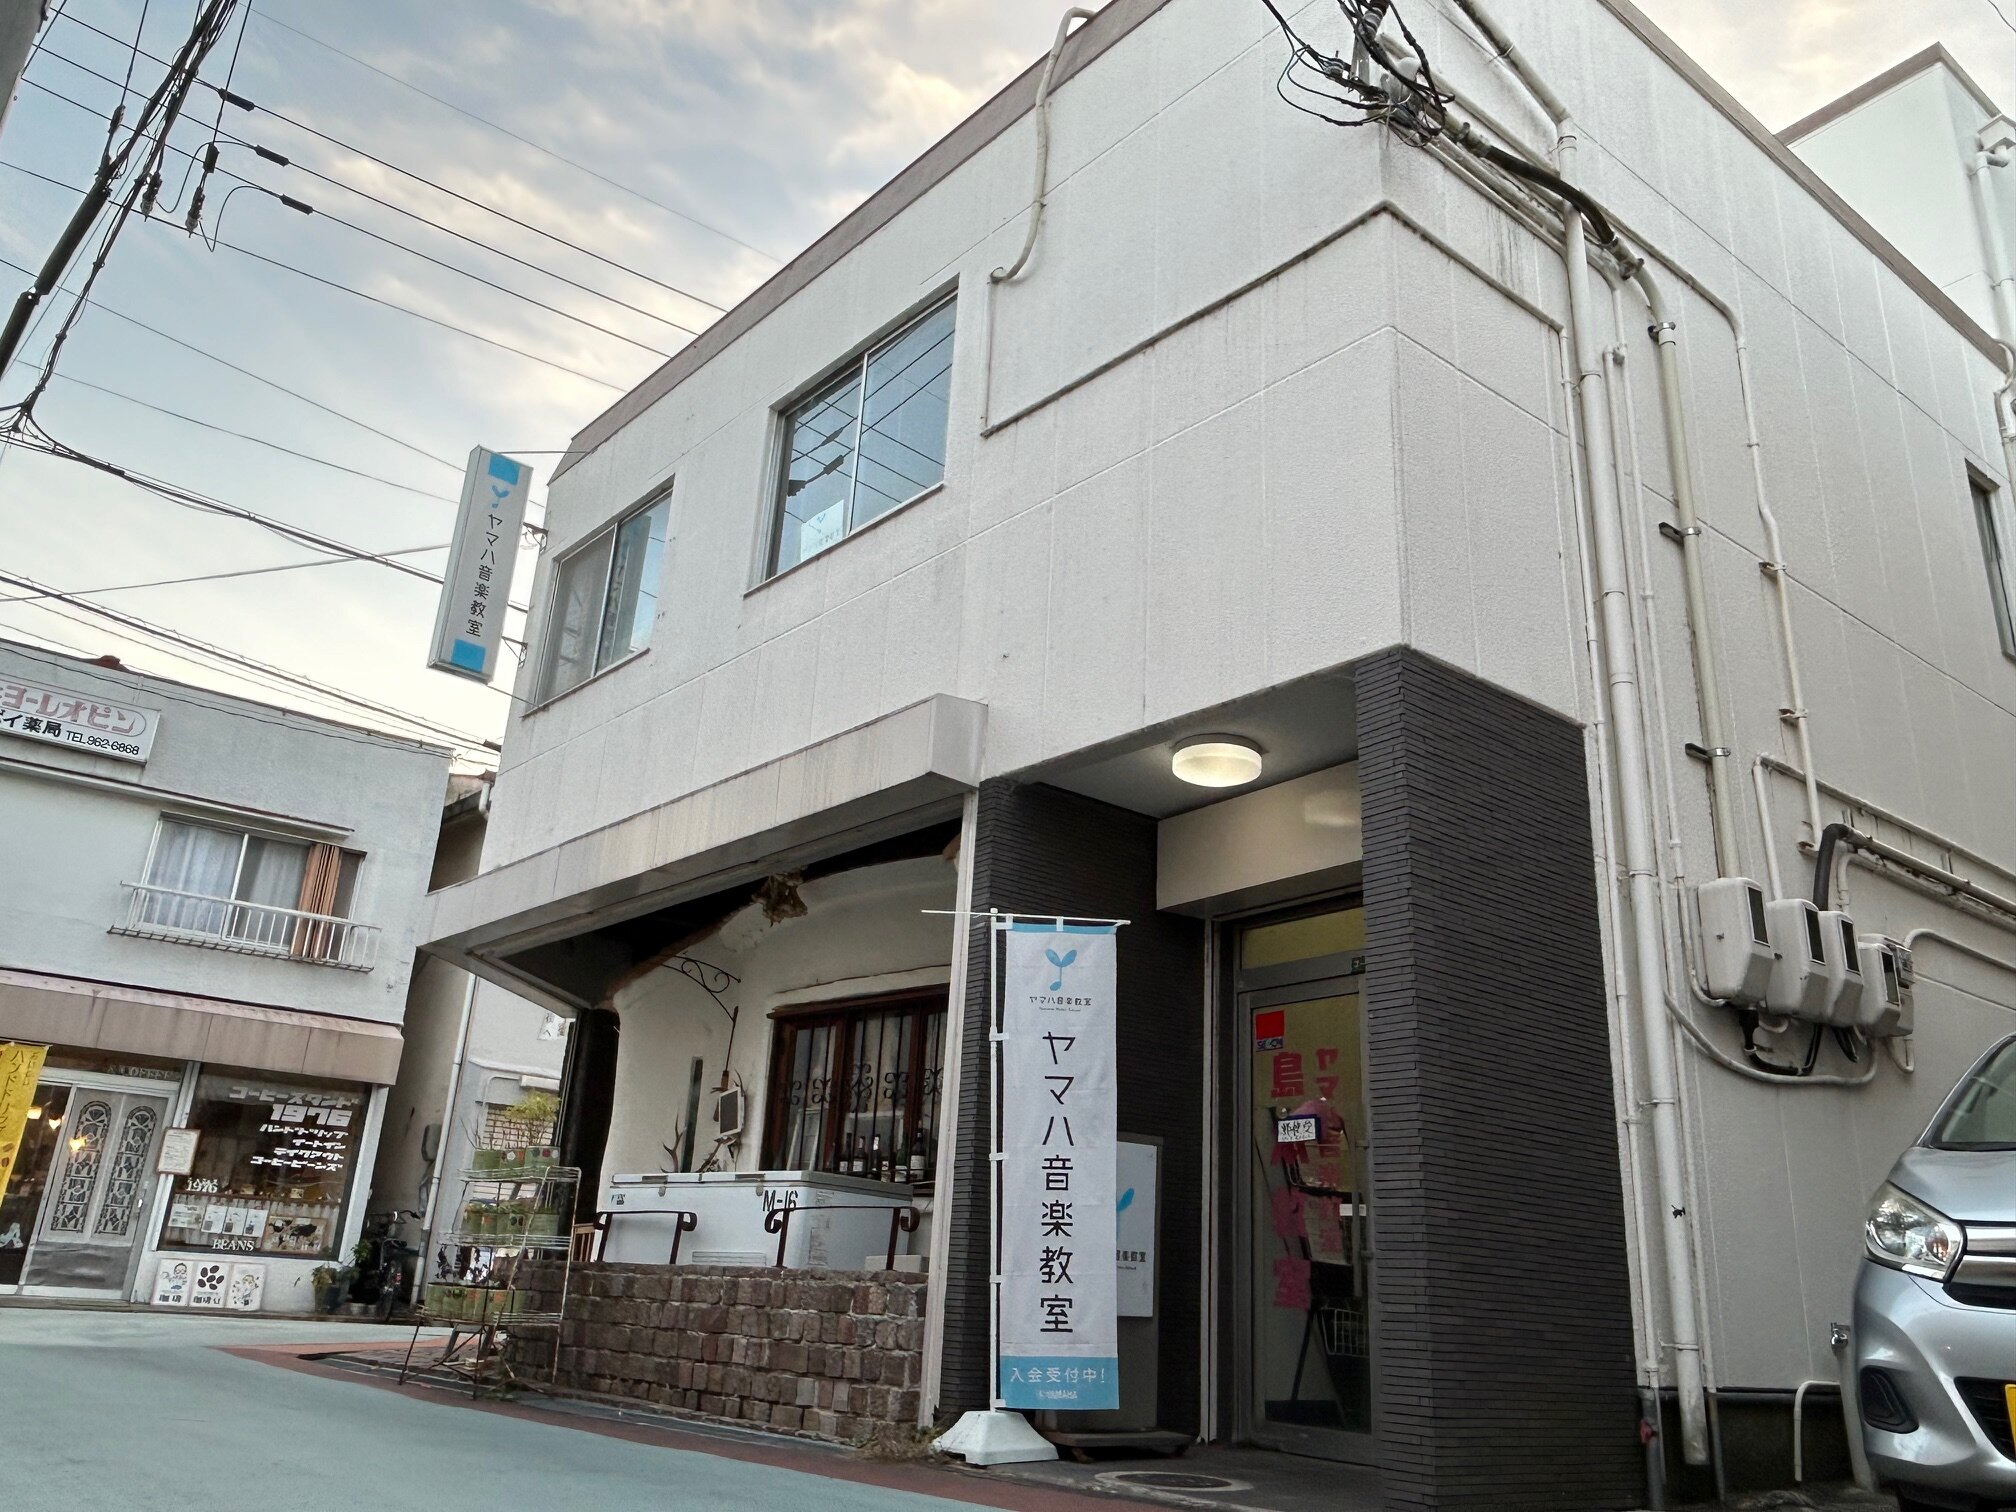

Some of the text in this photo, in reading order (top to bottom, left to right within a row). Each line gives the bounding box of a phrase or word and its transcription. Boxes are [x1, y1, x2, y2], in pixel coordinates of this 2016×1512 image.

[466, 513, 503, 637] ヤマハ音楽教室
[0, 685, 135, 734] ヨーレオピン
[229, 1086, 360, 1109] コーヒースタンド
[270, 1103, 352, 1127] 1976
[273, 1147, 345, 1161] テイクアウト
[292, 1138, 346, 1150] イートイン
[250, 1156, 343, 1172] コーヒービーンズ
[1040, 1031, 1076, 1333] ヤマハ音楽教室
[212, 1238, 255, 1252] BEANS
